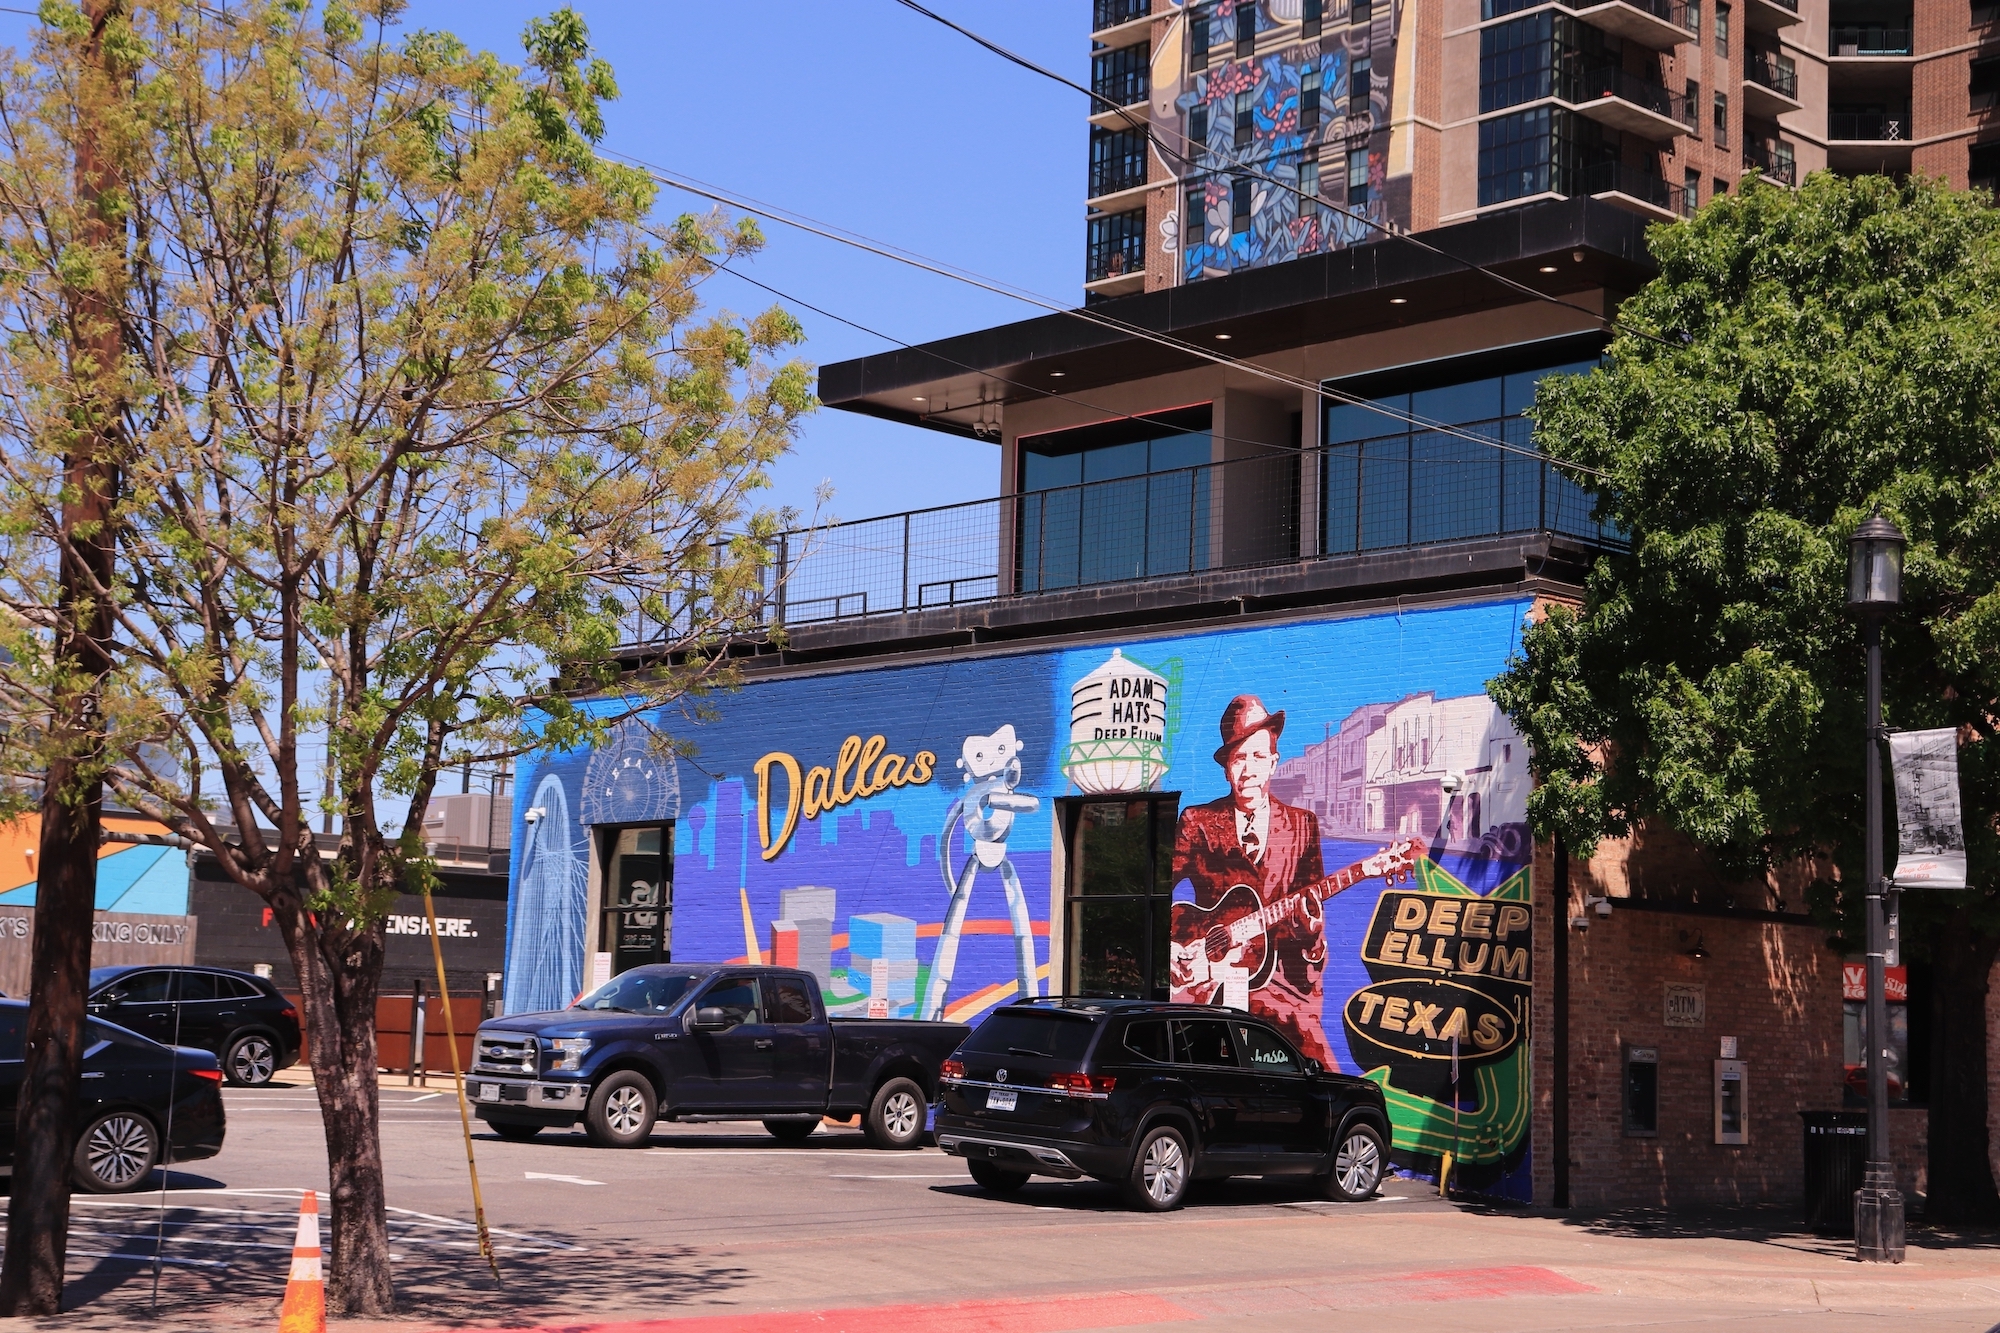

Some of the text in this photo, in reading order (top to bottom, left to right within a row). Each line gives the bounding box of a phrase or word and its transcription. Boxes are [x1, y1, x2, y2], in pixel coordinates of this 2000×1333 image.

[1109, 677, 1154, 700] ADAM
[1112, 701, 1150, 724] HATS
[1094, 727, 1127, 741] DEEP
[606, 757, 653, 798] TEXAS
[753, 734, 937, 861] Dallas
[134, 922, 189, 945] ONLY
[1394, 897, 1530, 942] DEEP
[1379, 931, 1530, 981] ELLUM
[1358, 991, 1506, 1051] TEXAS
[1673, 996, 1696, 1014] ATM
